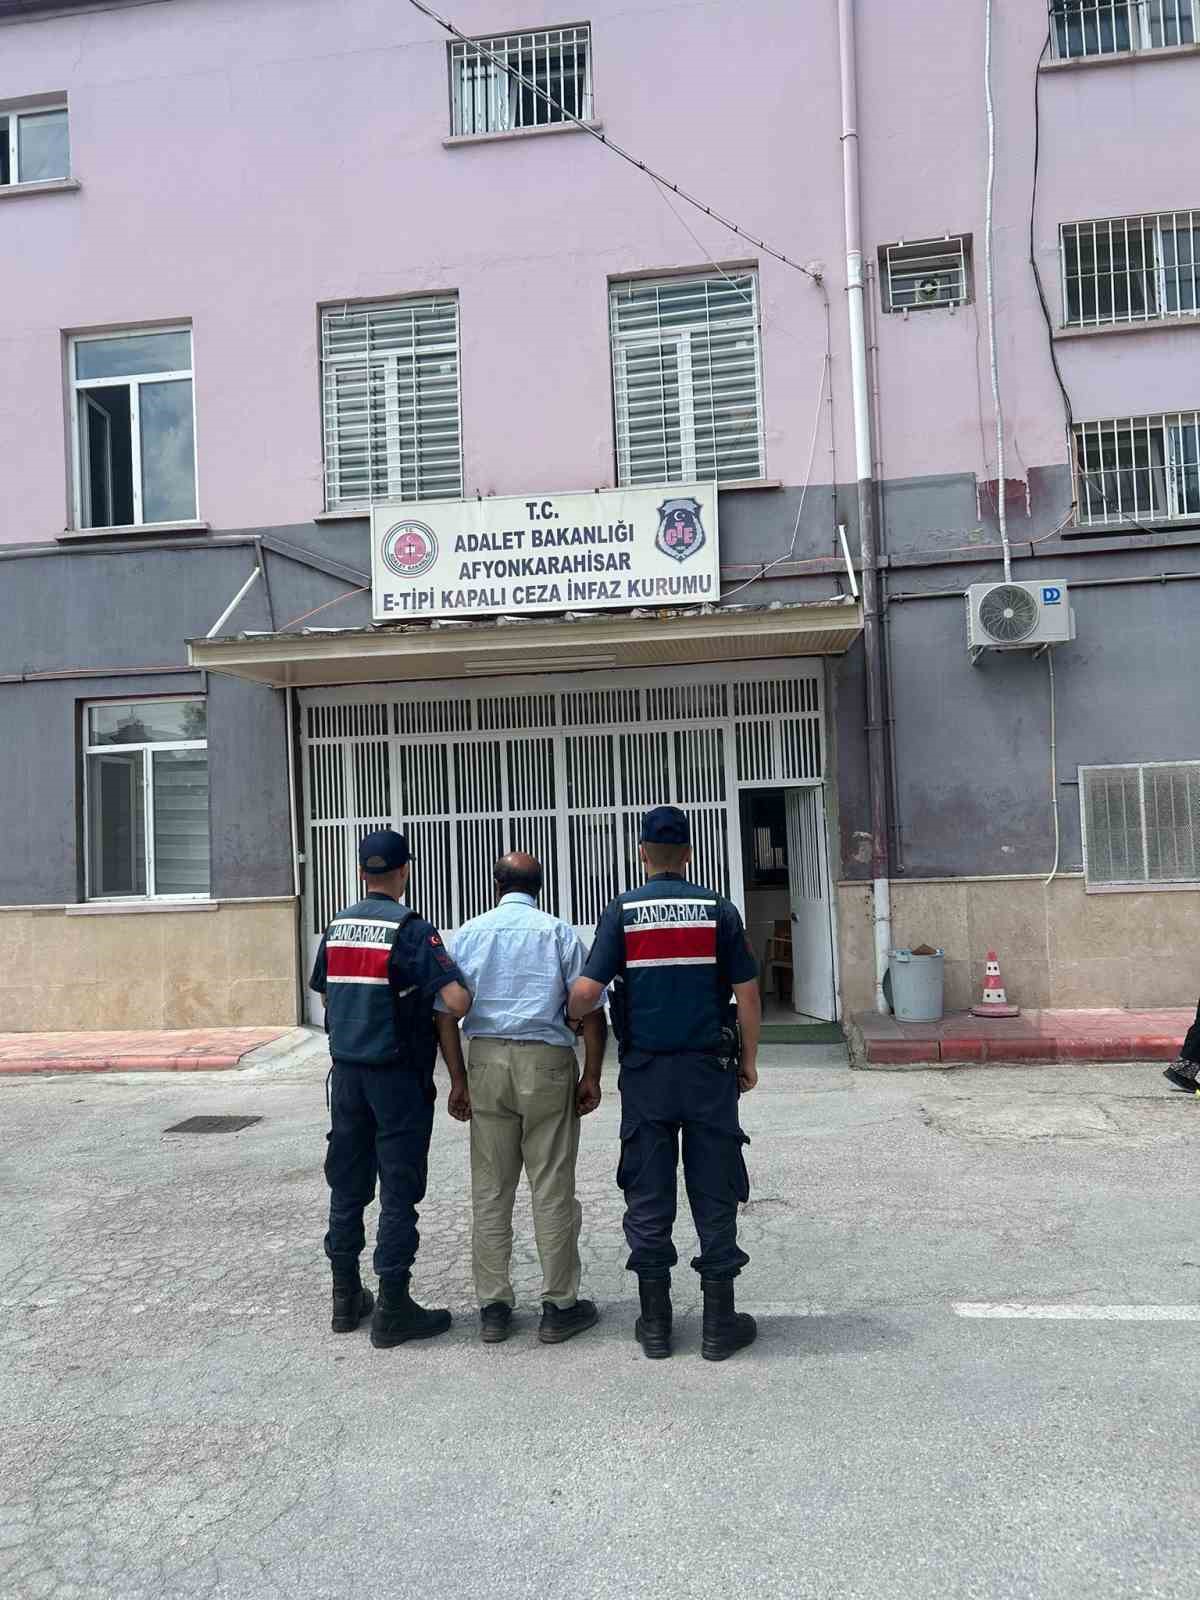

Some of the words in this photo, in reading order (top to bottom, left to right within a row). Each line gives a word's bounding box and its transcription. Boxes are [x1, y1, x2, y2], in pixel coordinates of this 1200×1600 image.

[526, 501, 559, 520] T.C.
[455, 530, 525, 552] ADALET
[532, 520, 634, 547] BAKANLIĞI
[459, 550, 631, 580] AFYONKARAHİSAR
[383, 587, 434, 611] E-TİPİ
[441, 588, 506, 608] KAPALI
[513, 584, 560, 604] CEZA
[567, 578, 621, 600] İNFAZ
[628, 574, 711, 597] KURUMU
[633, 904, 709, 924] JANDARMA
[330, 924, 387, 943] JANDARMA
